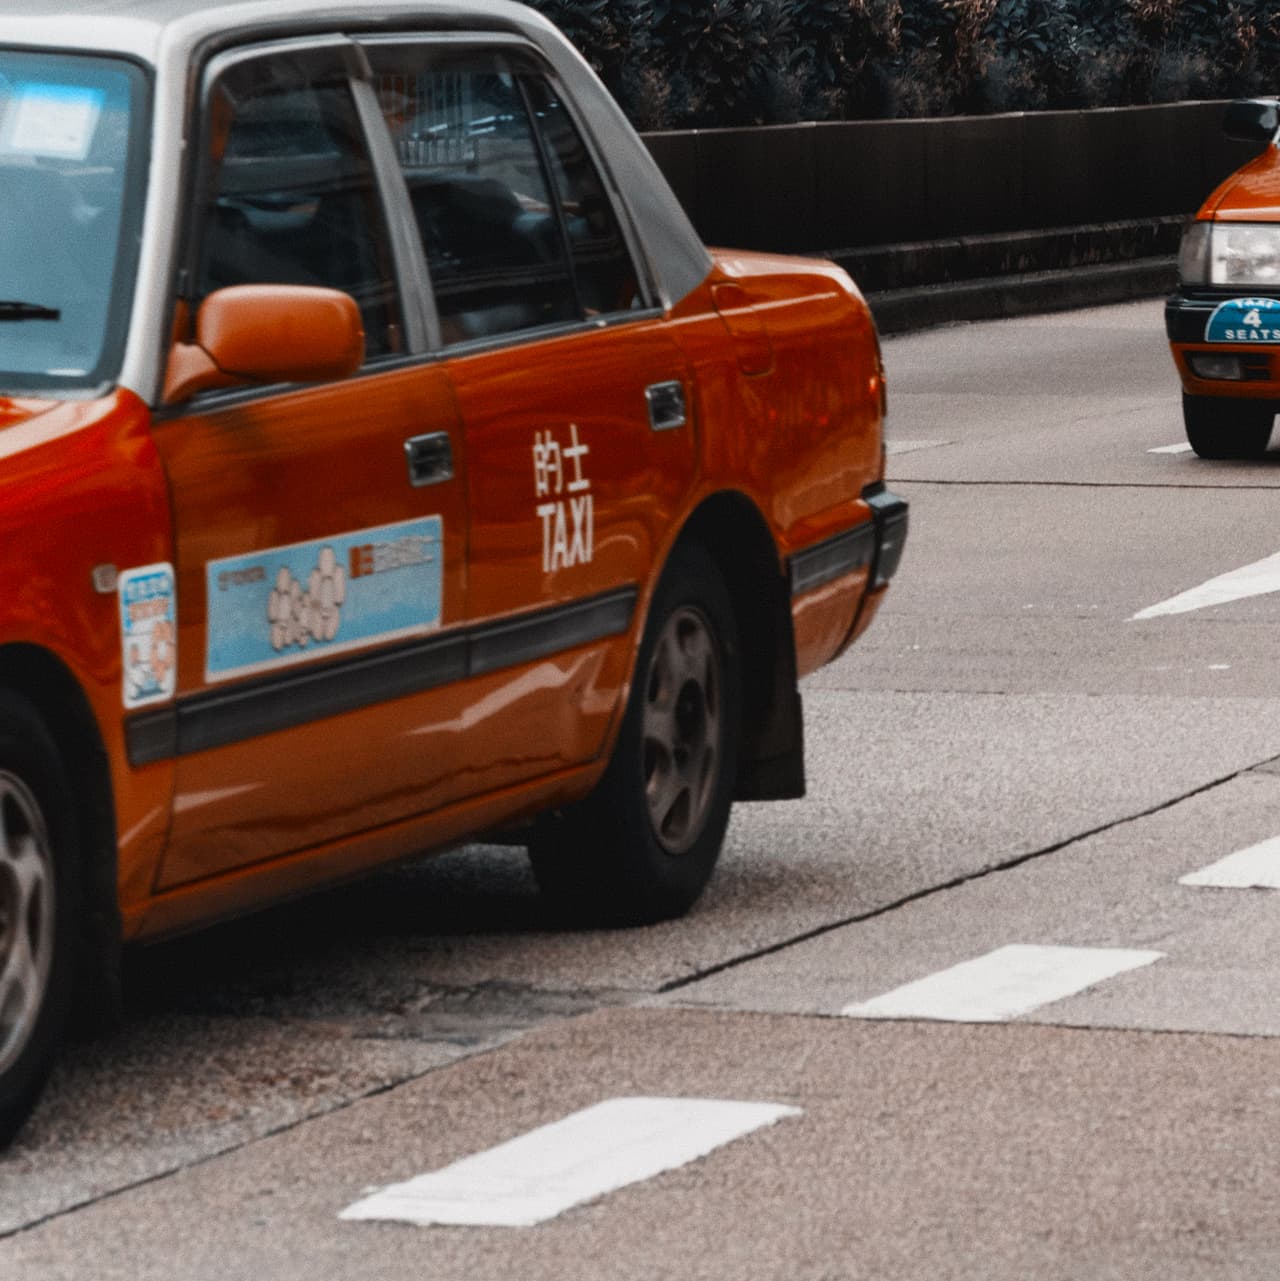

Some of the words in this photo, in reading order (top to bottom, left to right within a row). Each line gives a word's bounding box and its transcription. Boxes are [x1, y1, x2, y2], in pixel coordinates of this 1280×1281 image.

[1242, 308, 1262, 328] 4
[534, 425, 589, 498] 的士
[537, 499, 596, 574] TAXI
